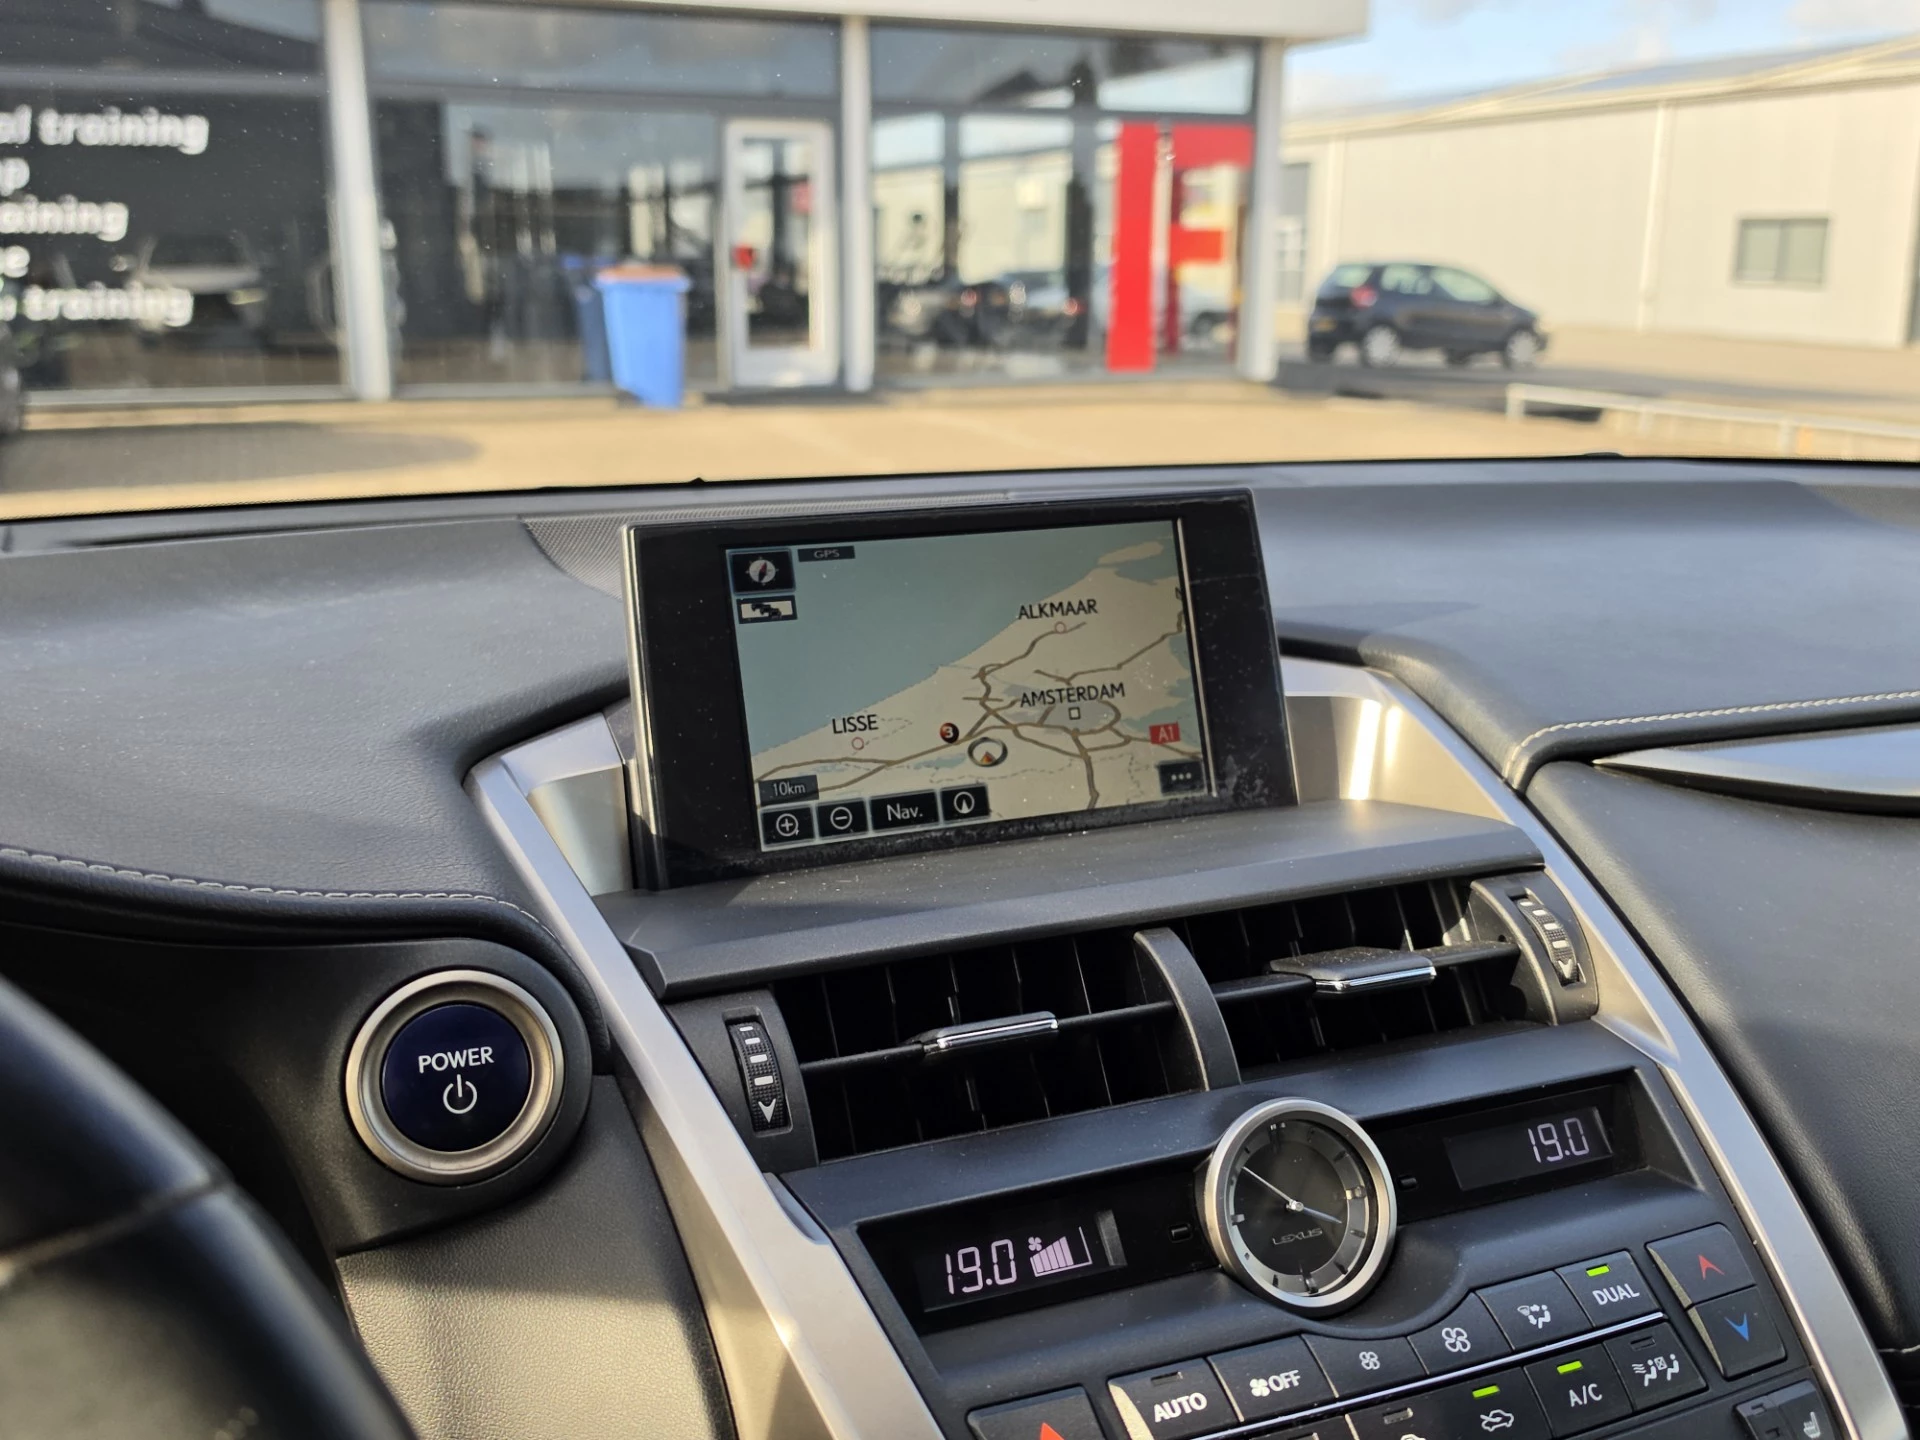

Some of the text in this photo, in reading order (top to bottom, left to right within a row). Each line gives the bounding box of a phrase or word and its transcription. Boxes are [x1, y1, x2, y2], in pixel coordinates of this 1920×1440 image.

[38, 107, 209, 155] training
[813, 549, 840, 559] GPS
[1018, 599, 1098, 620] ALKMAAR
[1020, 682, 1126, 708] AMSTERDAM
[832, 714, 879, 734] LISSE
[1158, 725, 1175, 742] A1
[772, 782, 806, 797] 10km
[886, 804, 924, 821] Nav.
[418, 1046, 494, 1074] POWER
[1527, 1117, 1590, 1163] 19.0
[1272, 1228, 1323, 1245] LEXUS
[945, 1239, 1017, 1295] 19.0
[1592, 1283, 1640, 1306] DUAL
[1268, 1369, 1301, 1392] OFF
[1568, 1383, 1602, 1408] A/C
[1153, 1392, 1208, 1423] AUTO
